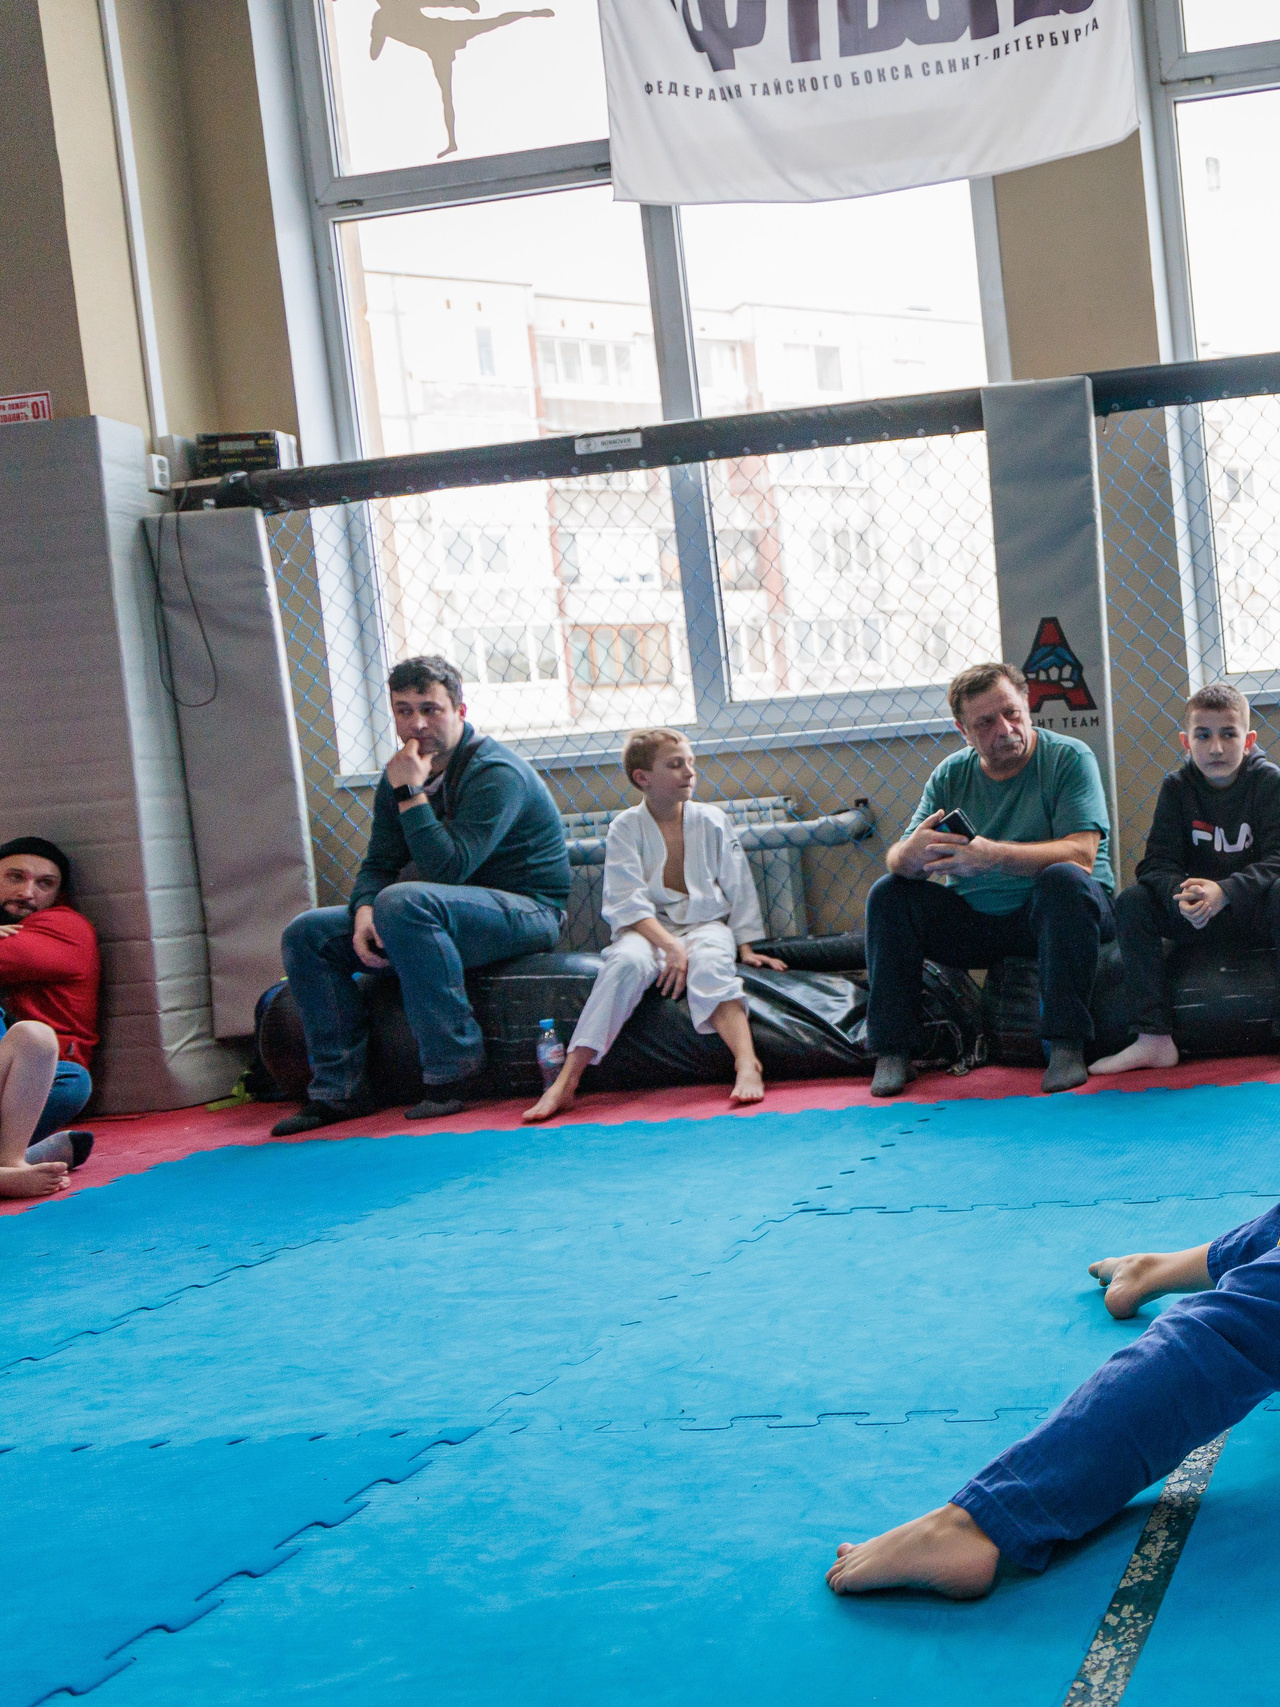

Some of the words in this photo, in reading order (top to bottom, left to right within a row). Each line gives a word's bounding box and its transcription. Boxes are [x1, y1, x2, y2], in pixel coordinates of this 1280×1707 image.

[644, 80, 742, 102] ФЕДЕРАЦИЯ
[750, 74, 842, 97] ТАЙСКОГО
[851, 64, 913, 86] БОКСА
[921, 17, 1099, 77] САНКТ-ПЕТЕРБУРГА
[31, 400, 46, 419] 01
[1062, 716, 1099, 728] TEAM
[1192, 820, 1254, 853] FILA
